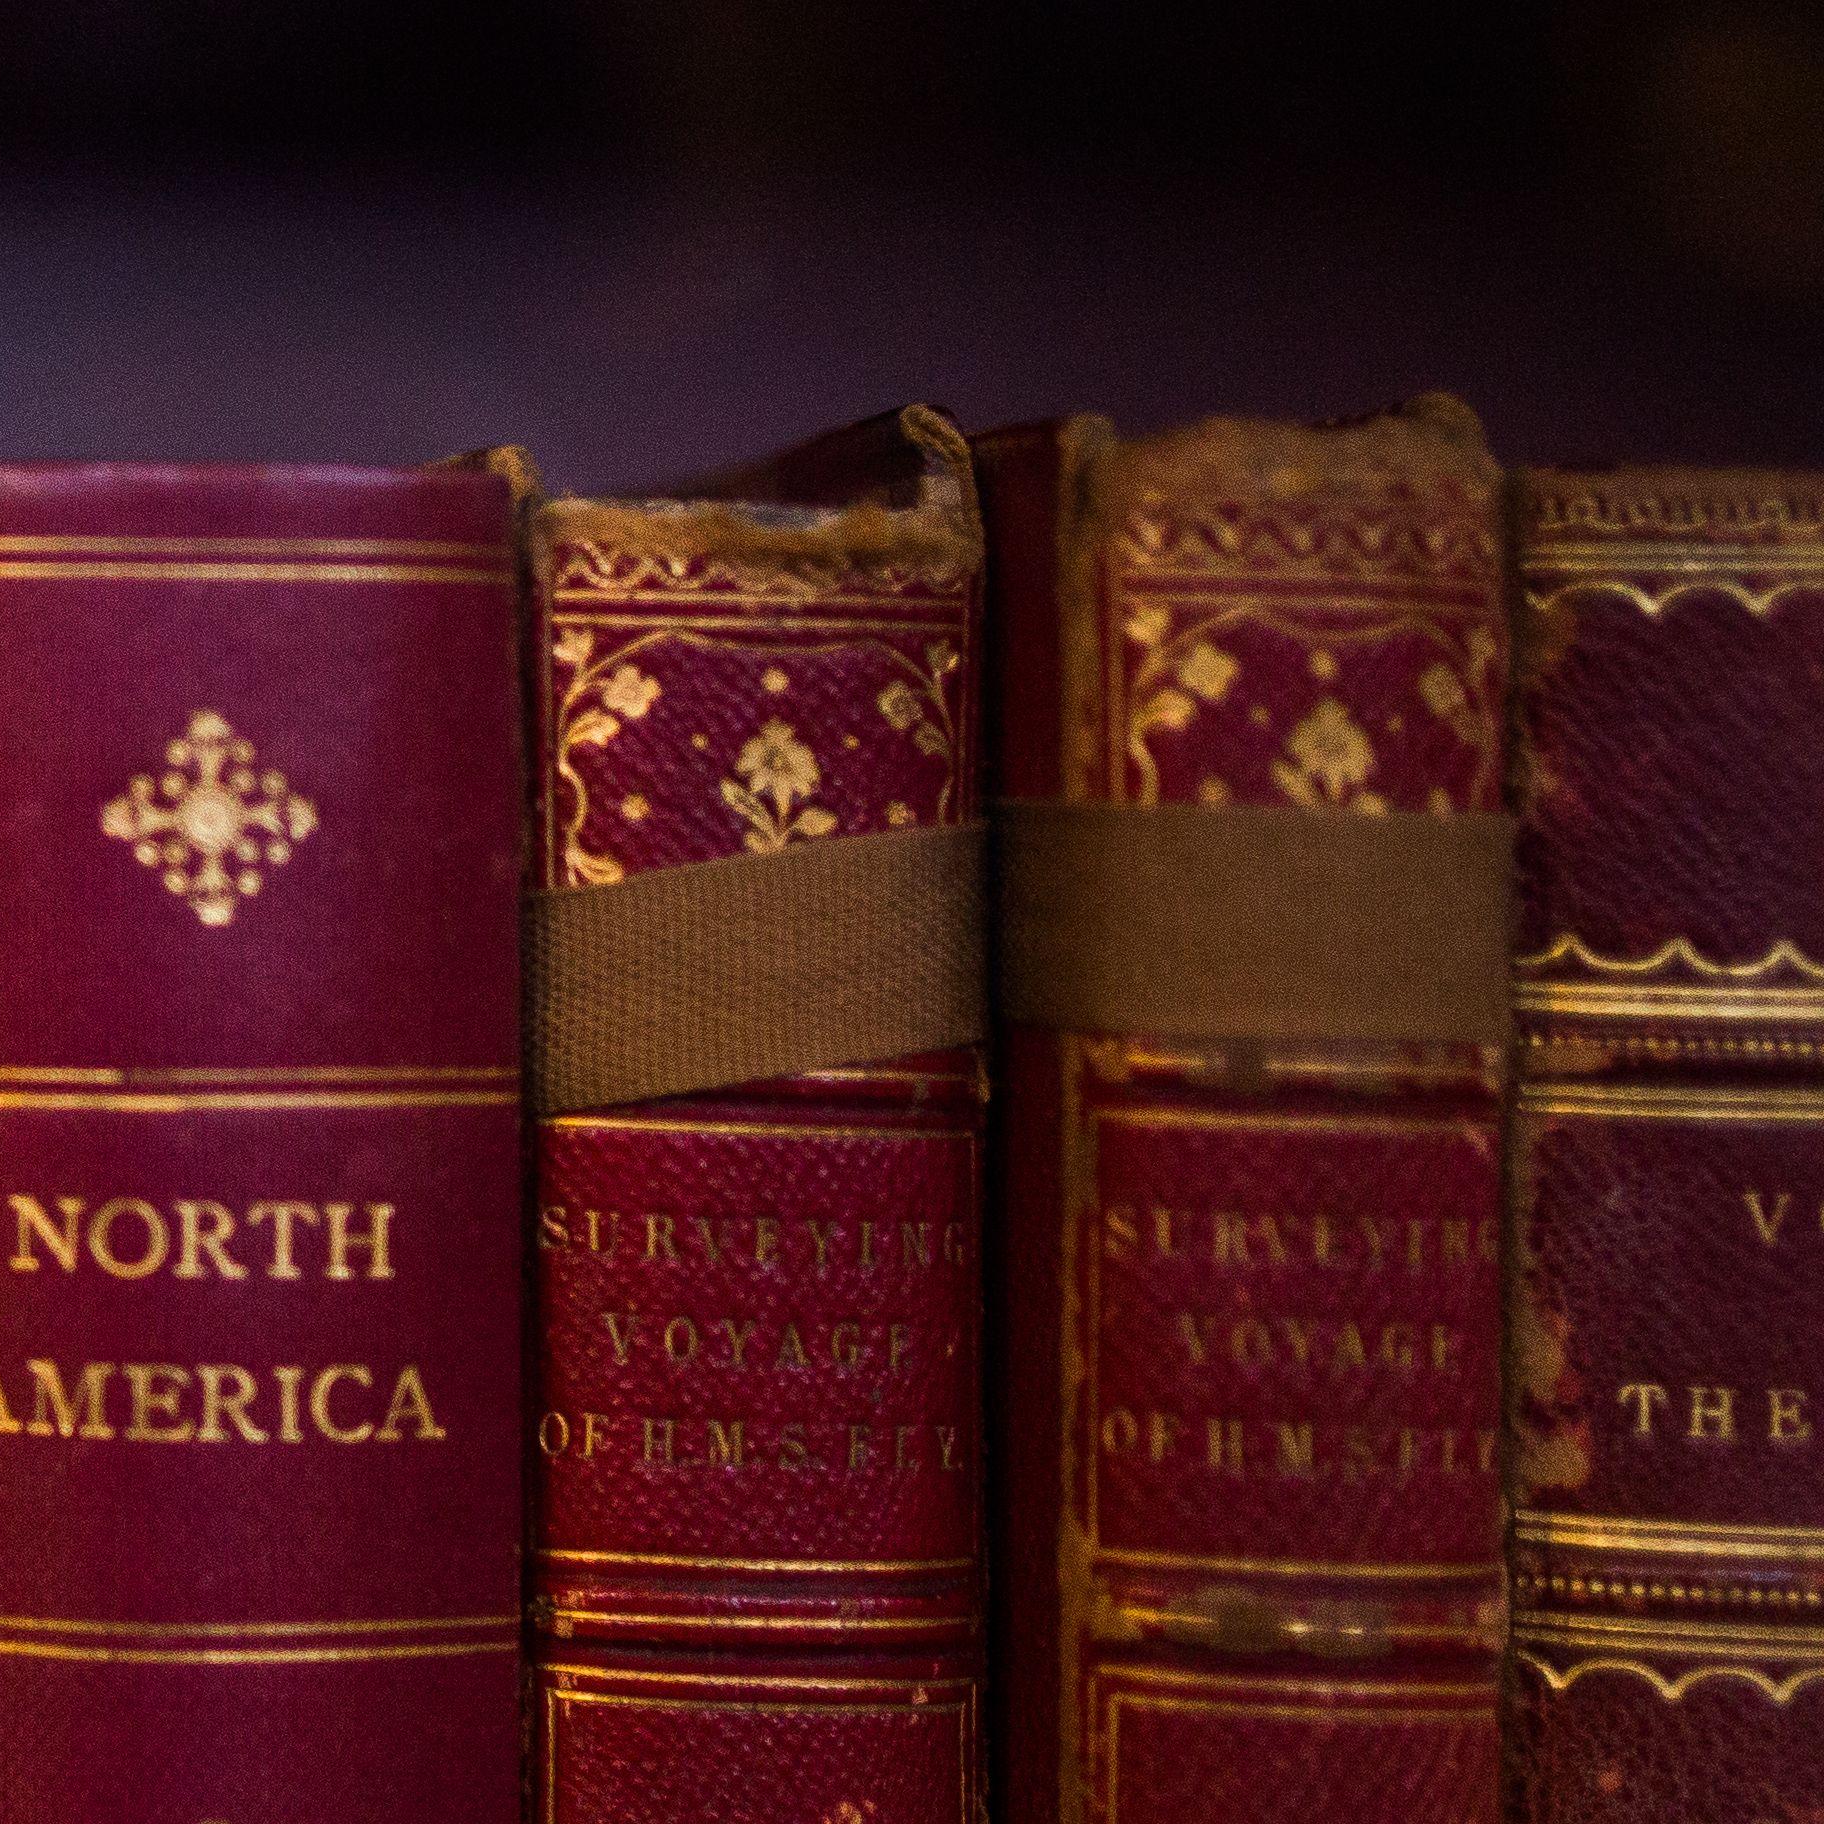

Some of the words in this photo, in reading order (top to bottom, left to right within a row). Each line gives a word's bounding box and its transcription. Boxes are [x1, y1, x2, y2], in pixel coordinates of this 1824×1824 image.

[8, 1193, 395, 1281] NORTH
[538, 1411, 609, 1462] OF
[1616, 1382, 1812, 1441] THE
